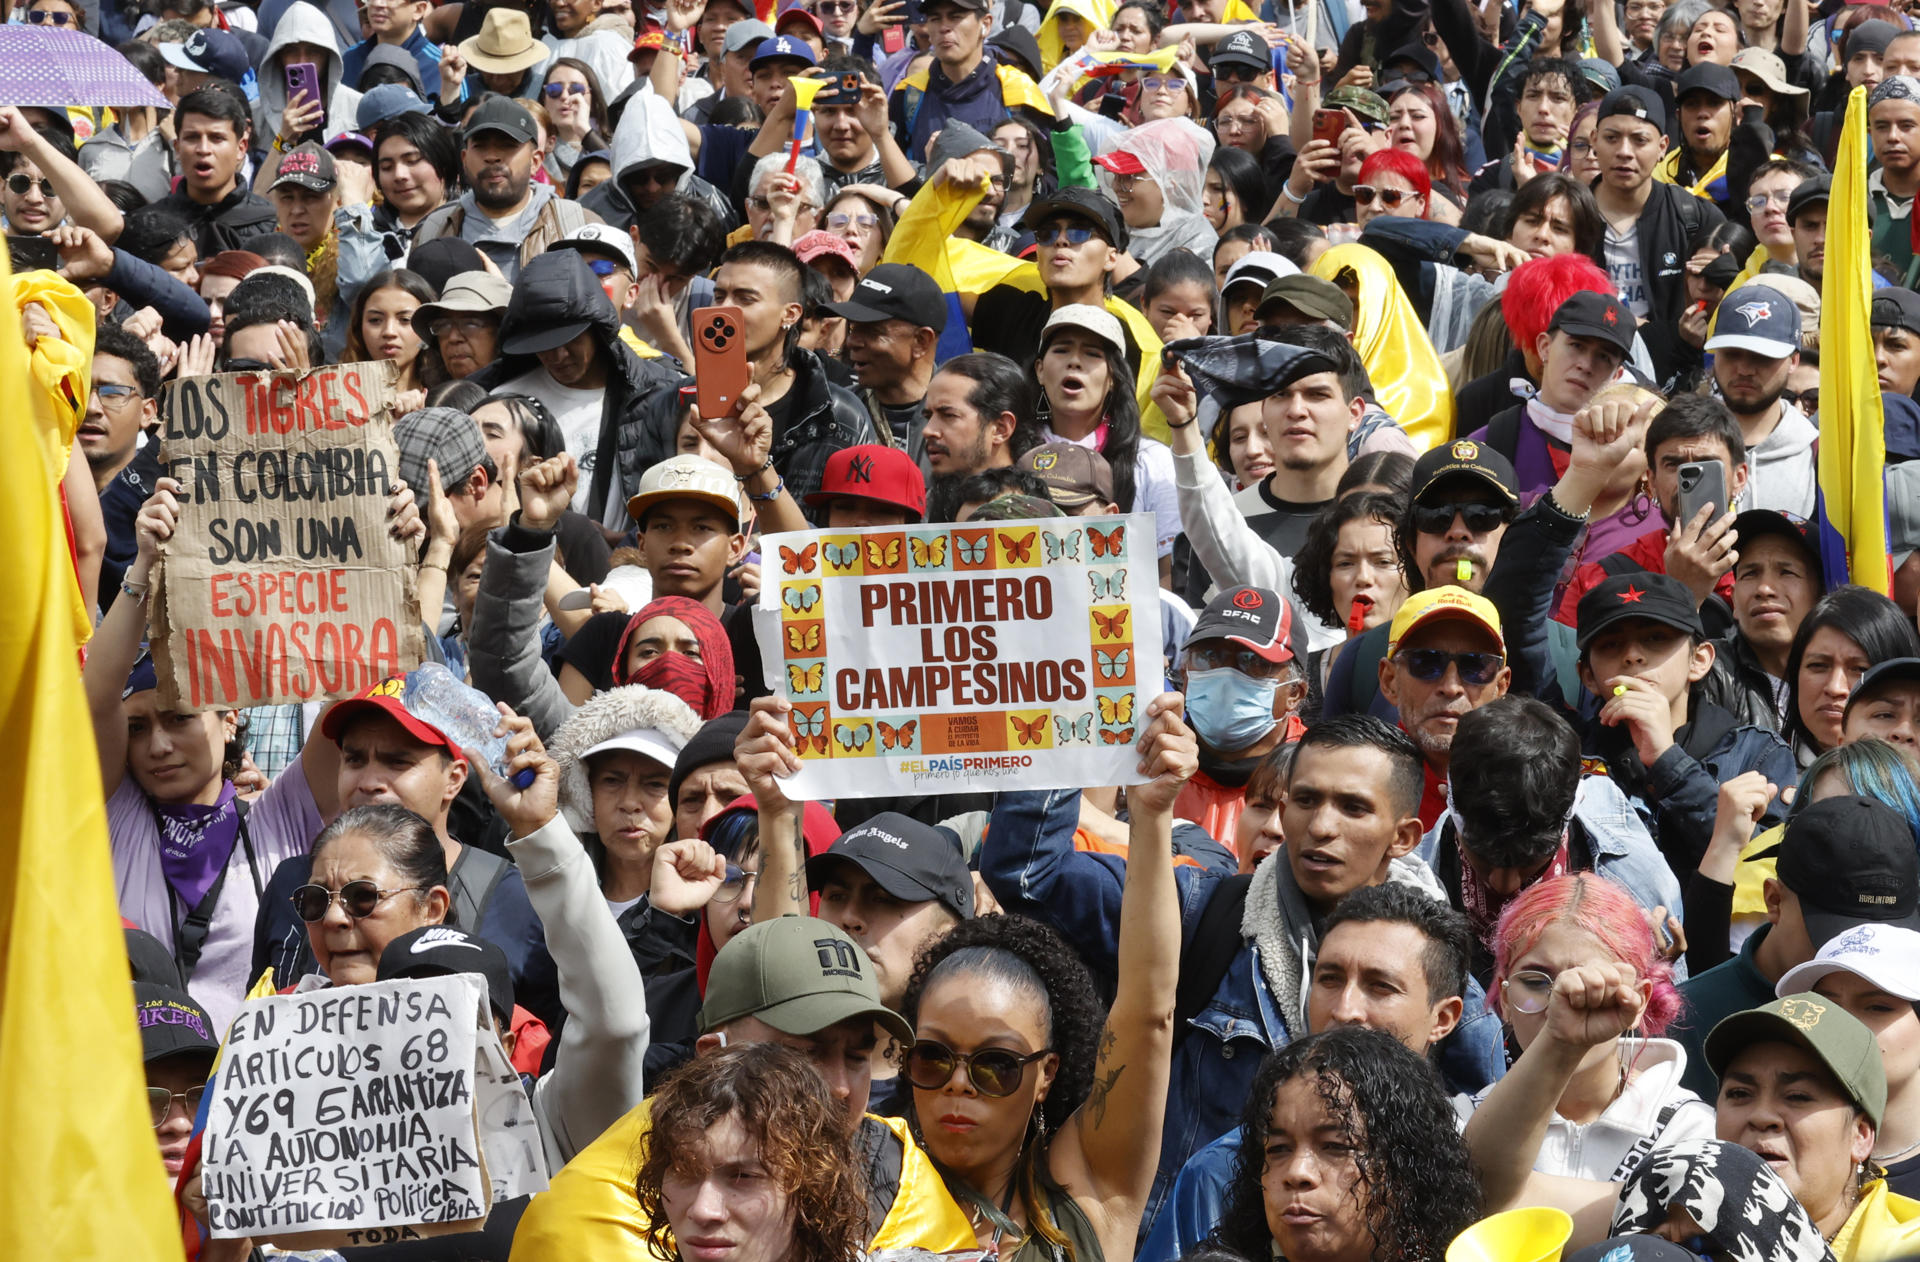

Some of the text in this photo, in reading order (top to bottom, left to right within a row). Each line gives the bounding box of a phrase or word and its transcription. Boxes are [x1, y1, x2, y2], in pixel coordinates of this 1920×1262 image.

[165, 371, 369, 440] LOS TIGRES
[168, 450, 220, 504] EN
[232, 447, 390, 504] COLOMBIA
[208, 515, 364, 565] SON UNA
[211, 568, 349, 617] ESPECIE
[860, 576, 1053, 628] PRIMERO
[185, 616, 399, 708] INVASORA
[920, 625, 998, 663] LOS
[835, 658, 1087, 711] CAMPESINOS
[947, 716, 978, 726] VAMOS
[957, 739, 965, 747] LA
[963, 768, 981, 785] que
[867, 827, 909, 850] Angels
[421, 928, 468, 943] NIKE
[138, 1004, 209, 1040] AKERS
[145, 999, 163, 1008] LOS
[228, 991, 451, 1045] EN DEFENSA
[401, 1028, 448, 1071] 68
[207, 1133, 248, 1166] LA
[347, 1226, 421, 1245] TODA
